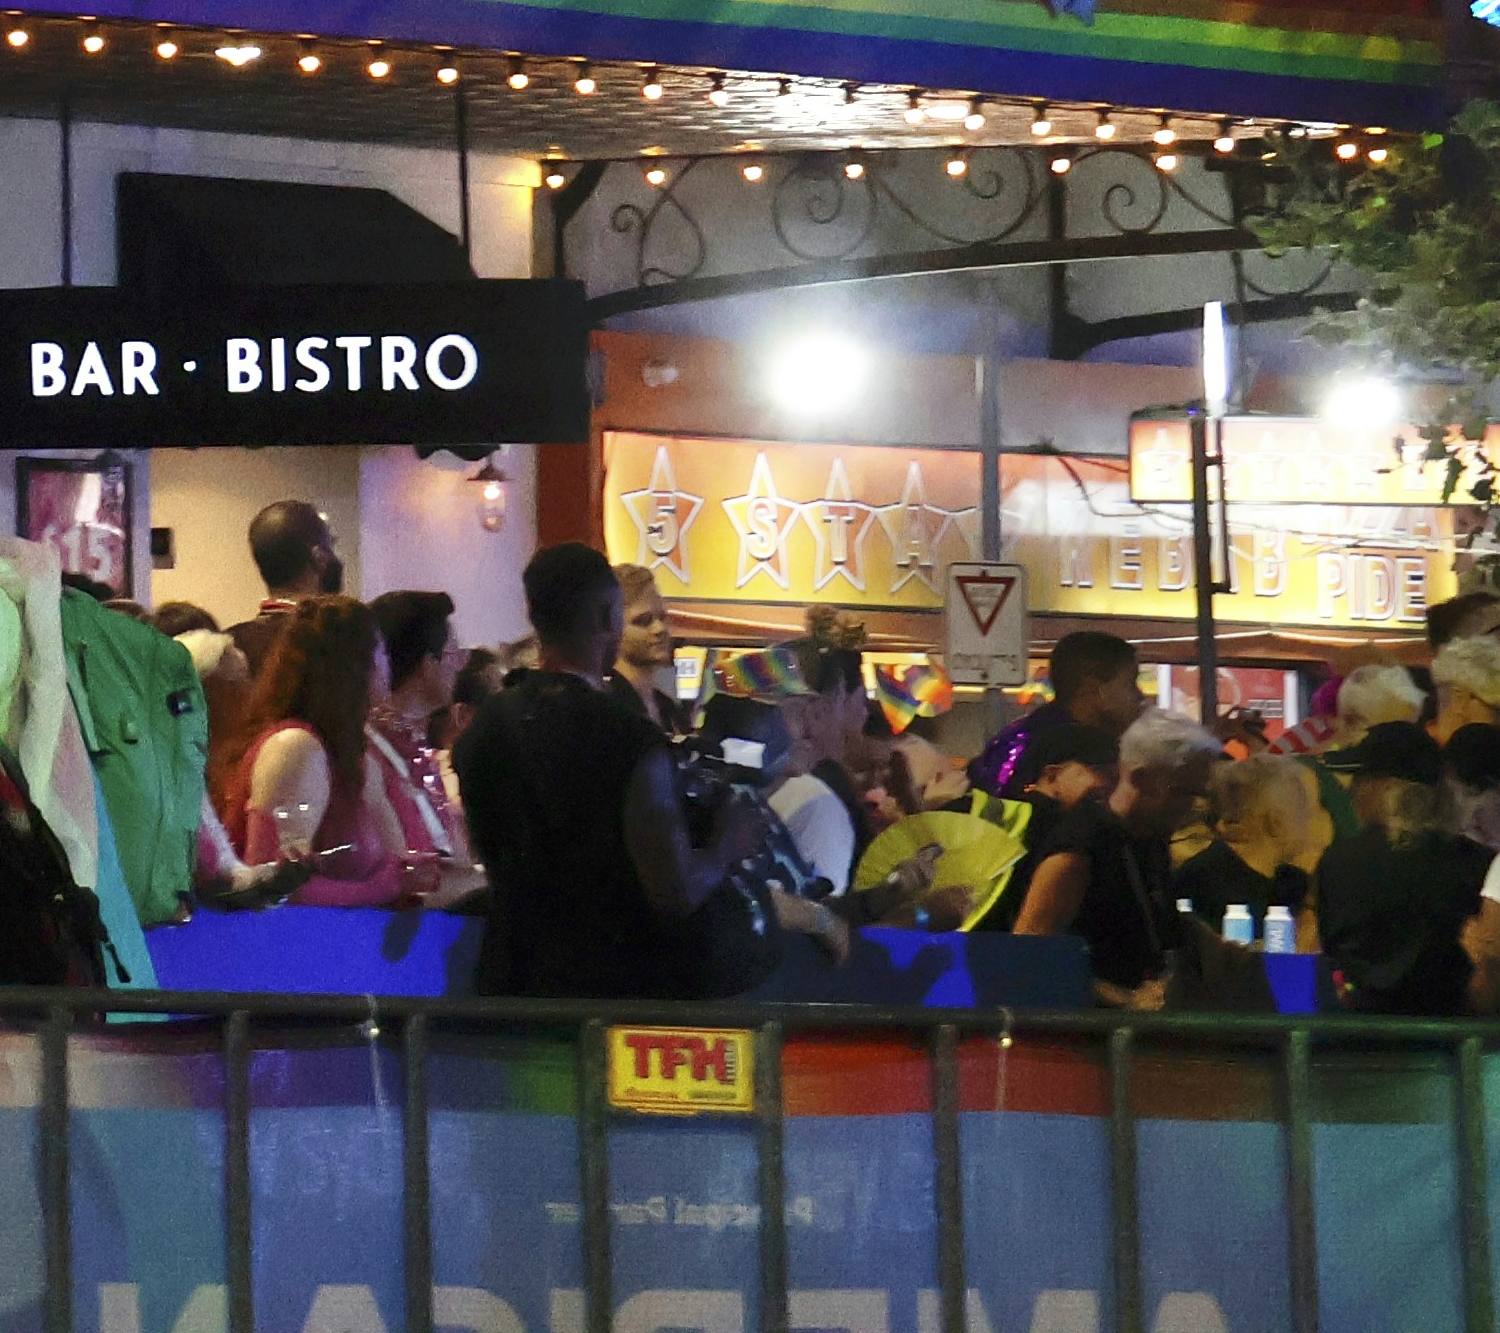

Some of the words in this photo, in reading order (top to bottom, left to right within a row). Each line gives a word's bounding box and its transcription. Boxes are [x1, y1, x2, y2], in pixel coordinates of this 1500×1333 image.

[30, 340, 160, 397] BAR
[226, 333, 481, 395] BISTRO
[648, 491, 677, 554] 5
[750, 493, 933, 569] STA
[1317, 551, 1428, 622] PIDE
[625, 1034, 729, 1083] TFH
